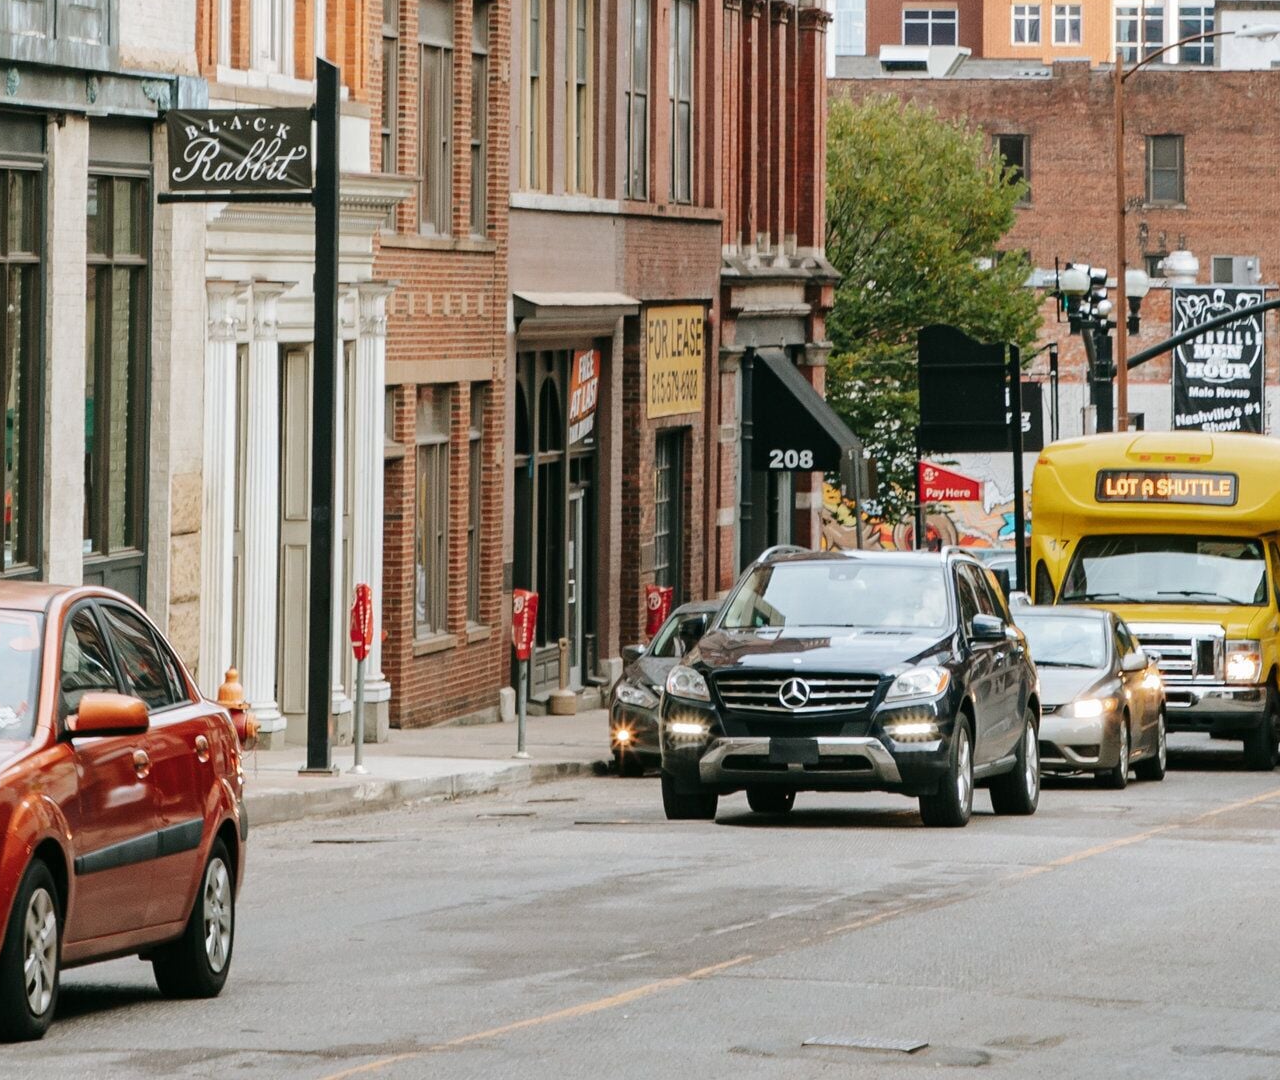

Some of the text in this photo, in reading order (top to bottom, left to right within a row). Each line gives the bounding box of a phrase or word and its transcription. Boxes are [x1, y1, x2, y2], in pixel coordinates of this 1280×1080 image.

[172, 137, 307, 182] Rabbit
[649, 318, 702, 360] FOR LEASE
[1193, 344, 1243, 359] MEN
[1186, 362, 1251, 379] HOUR
[1188, 386, 1251, 399] Male Revue
[1175, 402, 1261, 427] Nashville's #1
[1201, 418, 1241, 433] Show!
[770, 449, 814, 469] 208
[925, 487, 971, 500] Pay Here
[1106, 479, 1231, 496] LOT A SHUTTLE
[1049, 539, 1070, 550] 17
